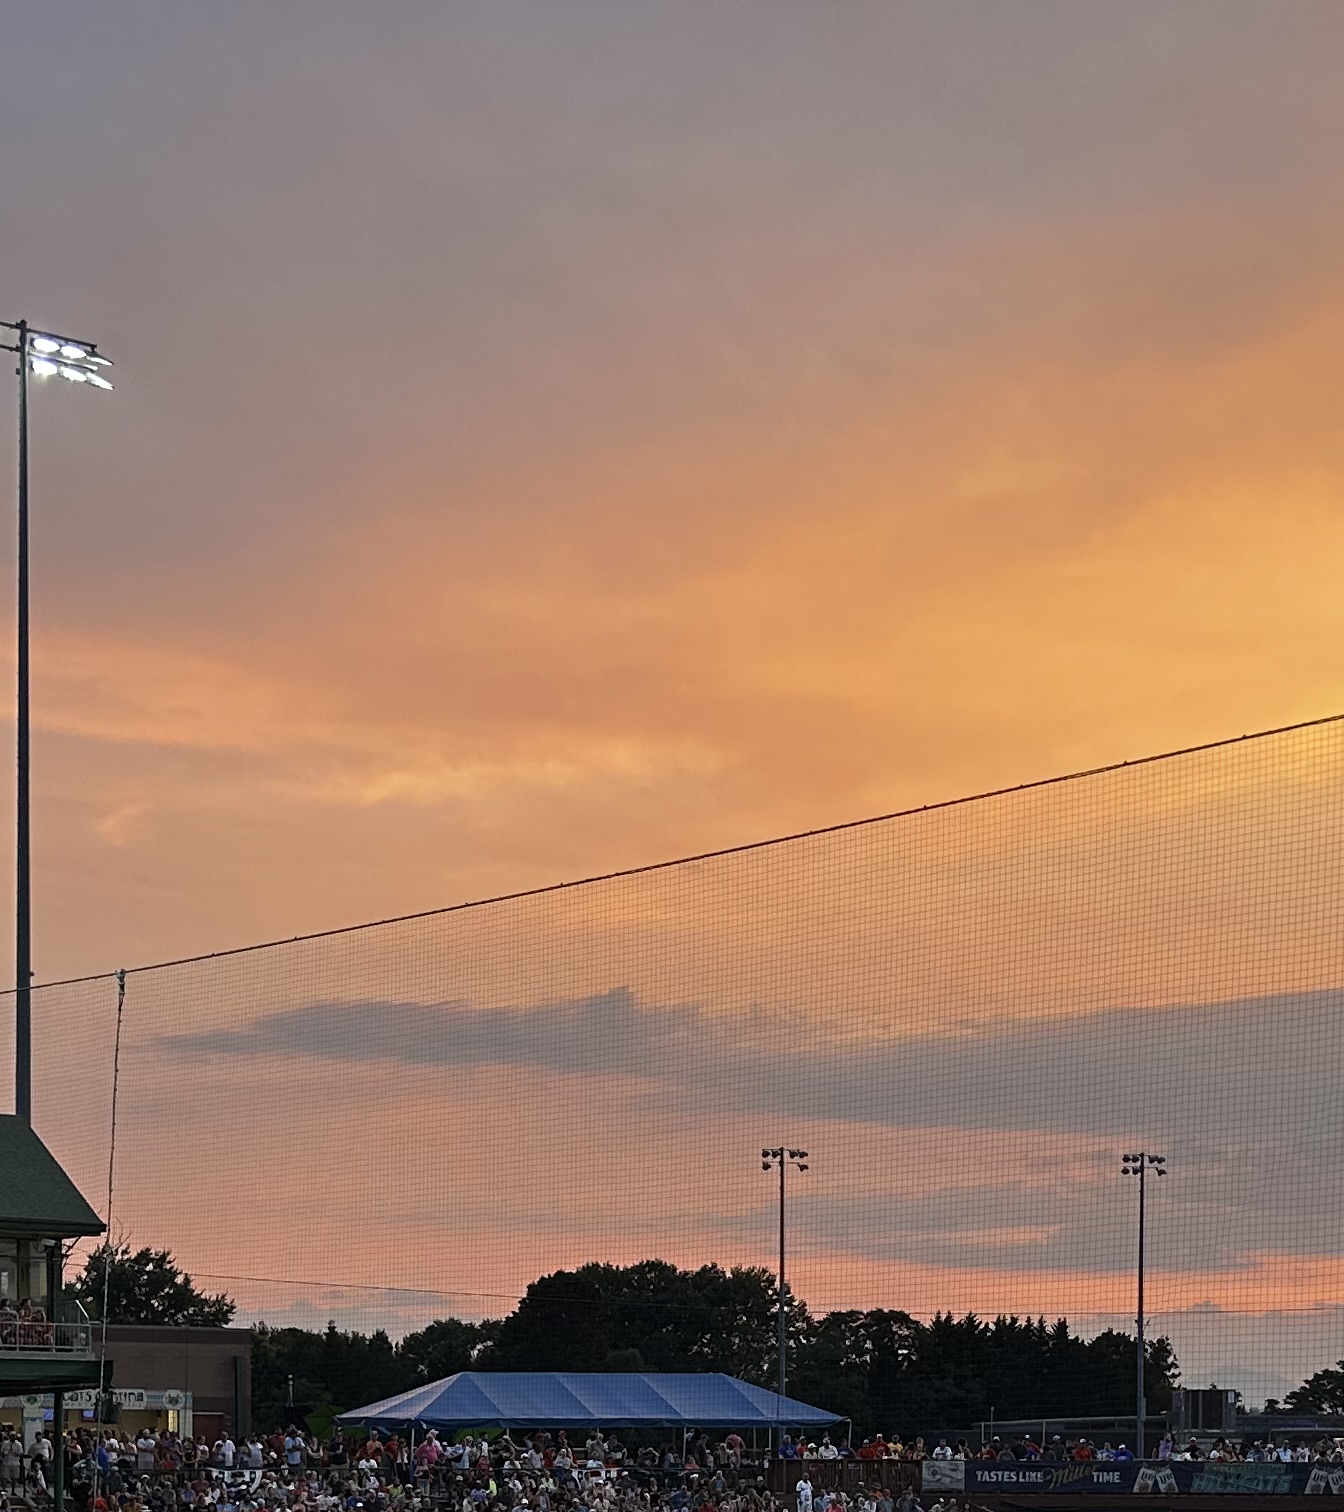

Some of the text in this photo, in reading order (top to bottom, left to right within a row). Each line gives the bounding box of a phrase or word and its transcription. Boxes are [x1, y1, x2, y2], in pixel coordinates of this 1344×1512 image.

[975, 1463, 1121, 1490] TASTES LIKE Miller TIME
